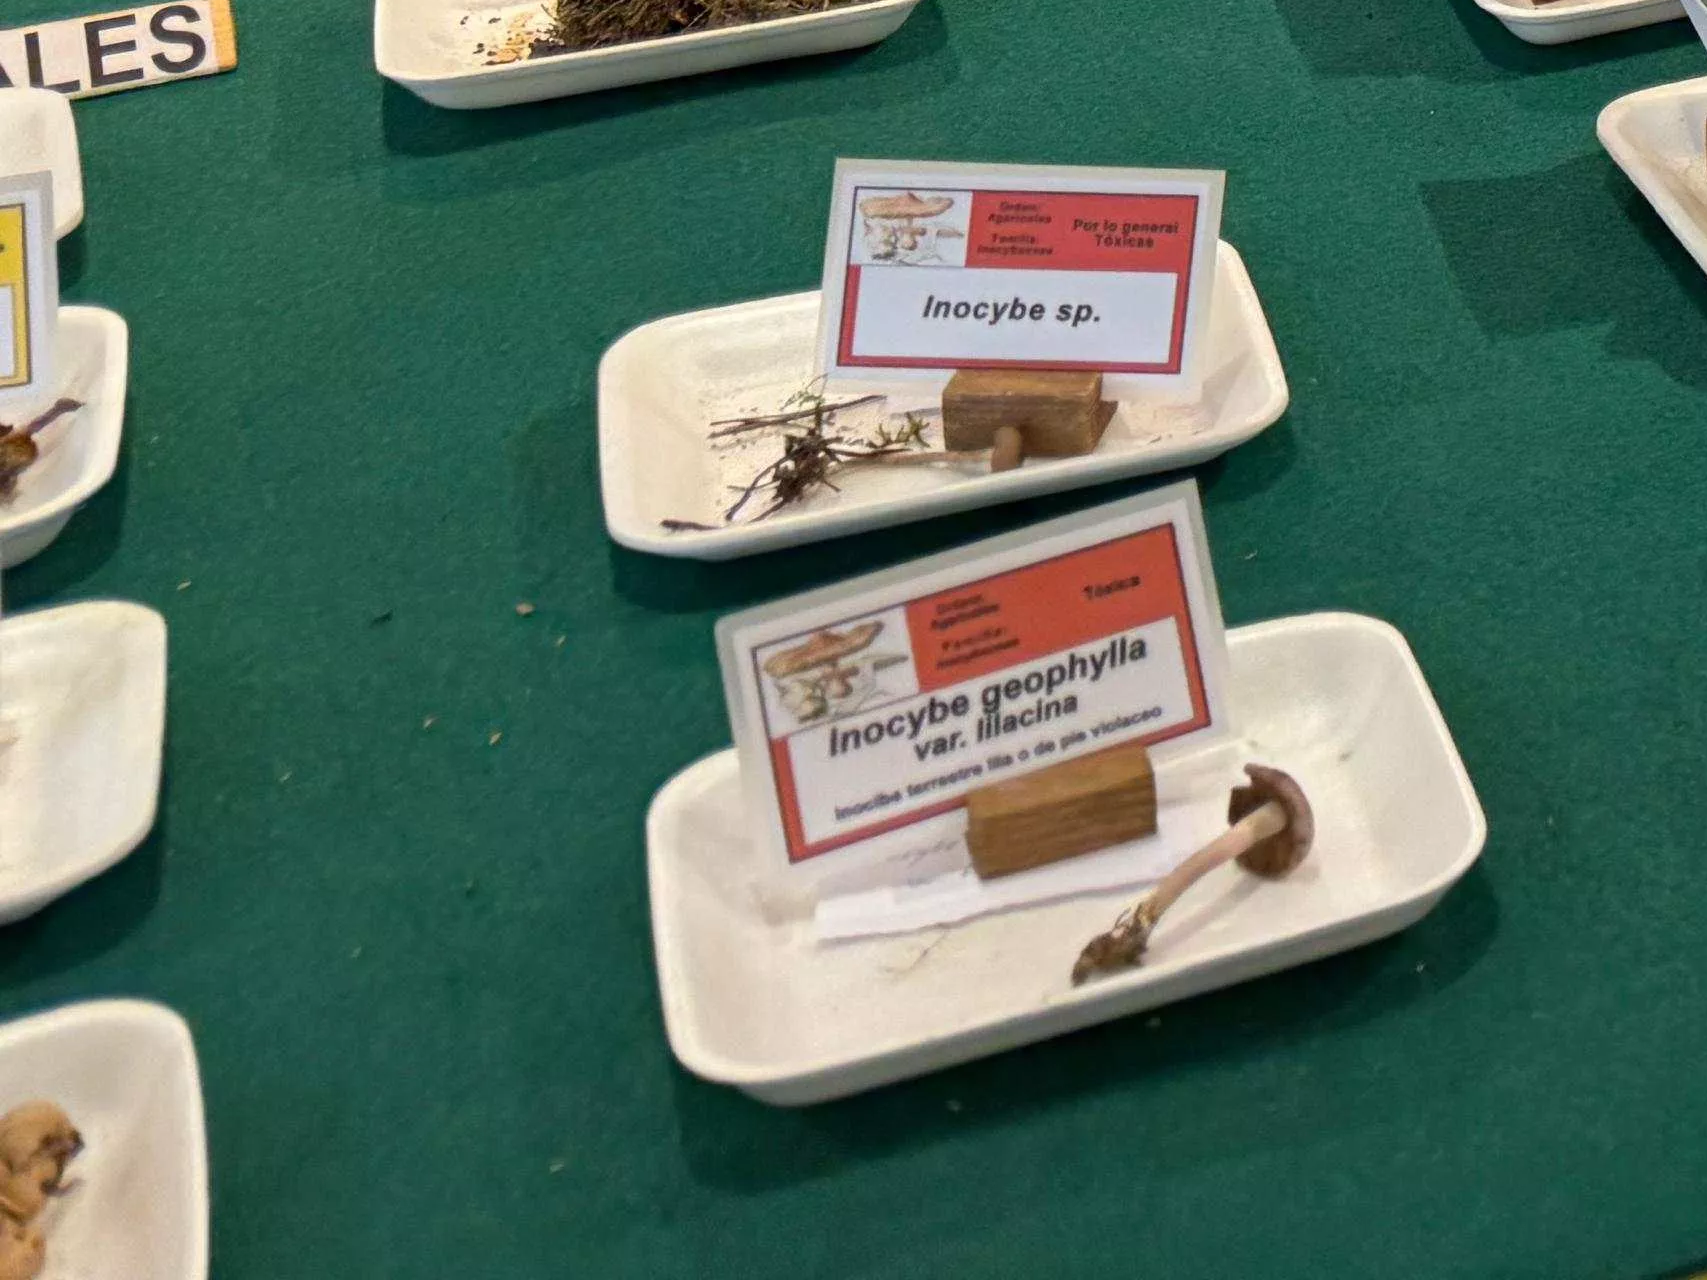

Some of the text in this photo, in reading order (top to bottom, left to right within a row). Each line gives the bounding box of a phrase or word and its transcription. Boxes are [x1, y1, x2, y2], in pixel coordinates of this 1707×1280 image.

[0, 4, 207, 93] LES
[1073, 218, 1180, 237] Por lo general
[922, 294, 1101, 325] Inocybe sp.
[829, 635, 1148, 757] Inocybe geophylla
[914, 693, 1078, 761] var. lilacina
[1034, 736, 1057, 755] de
